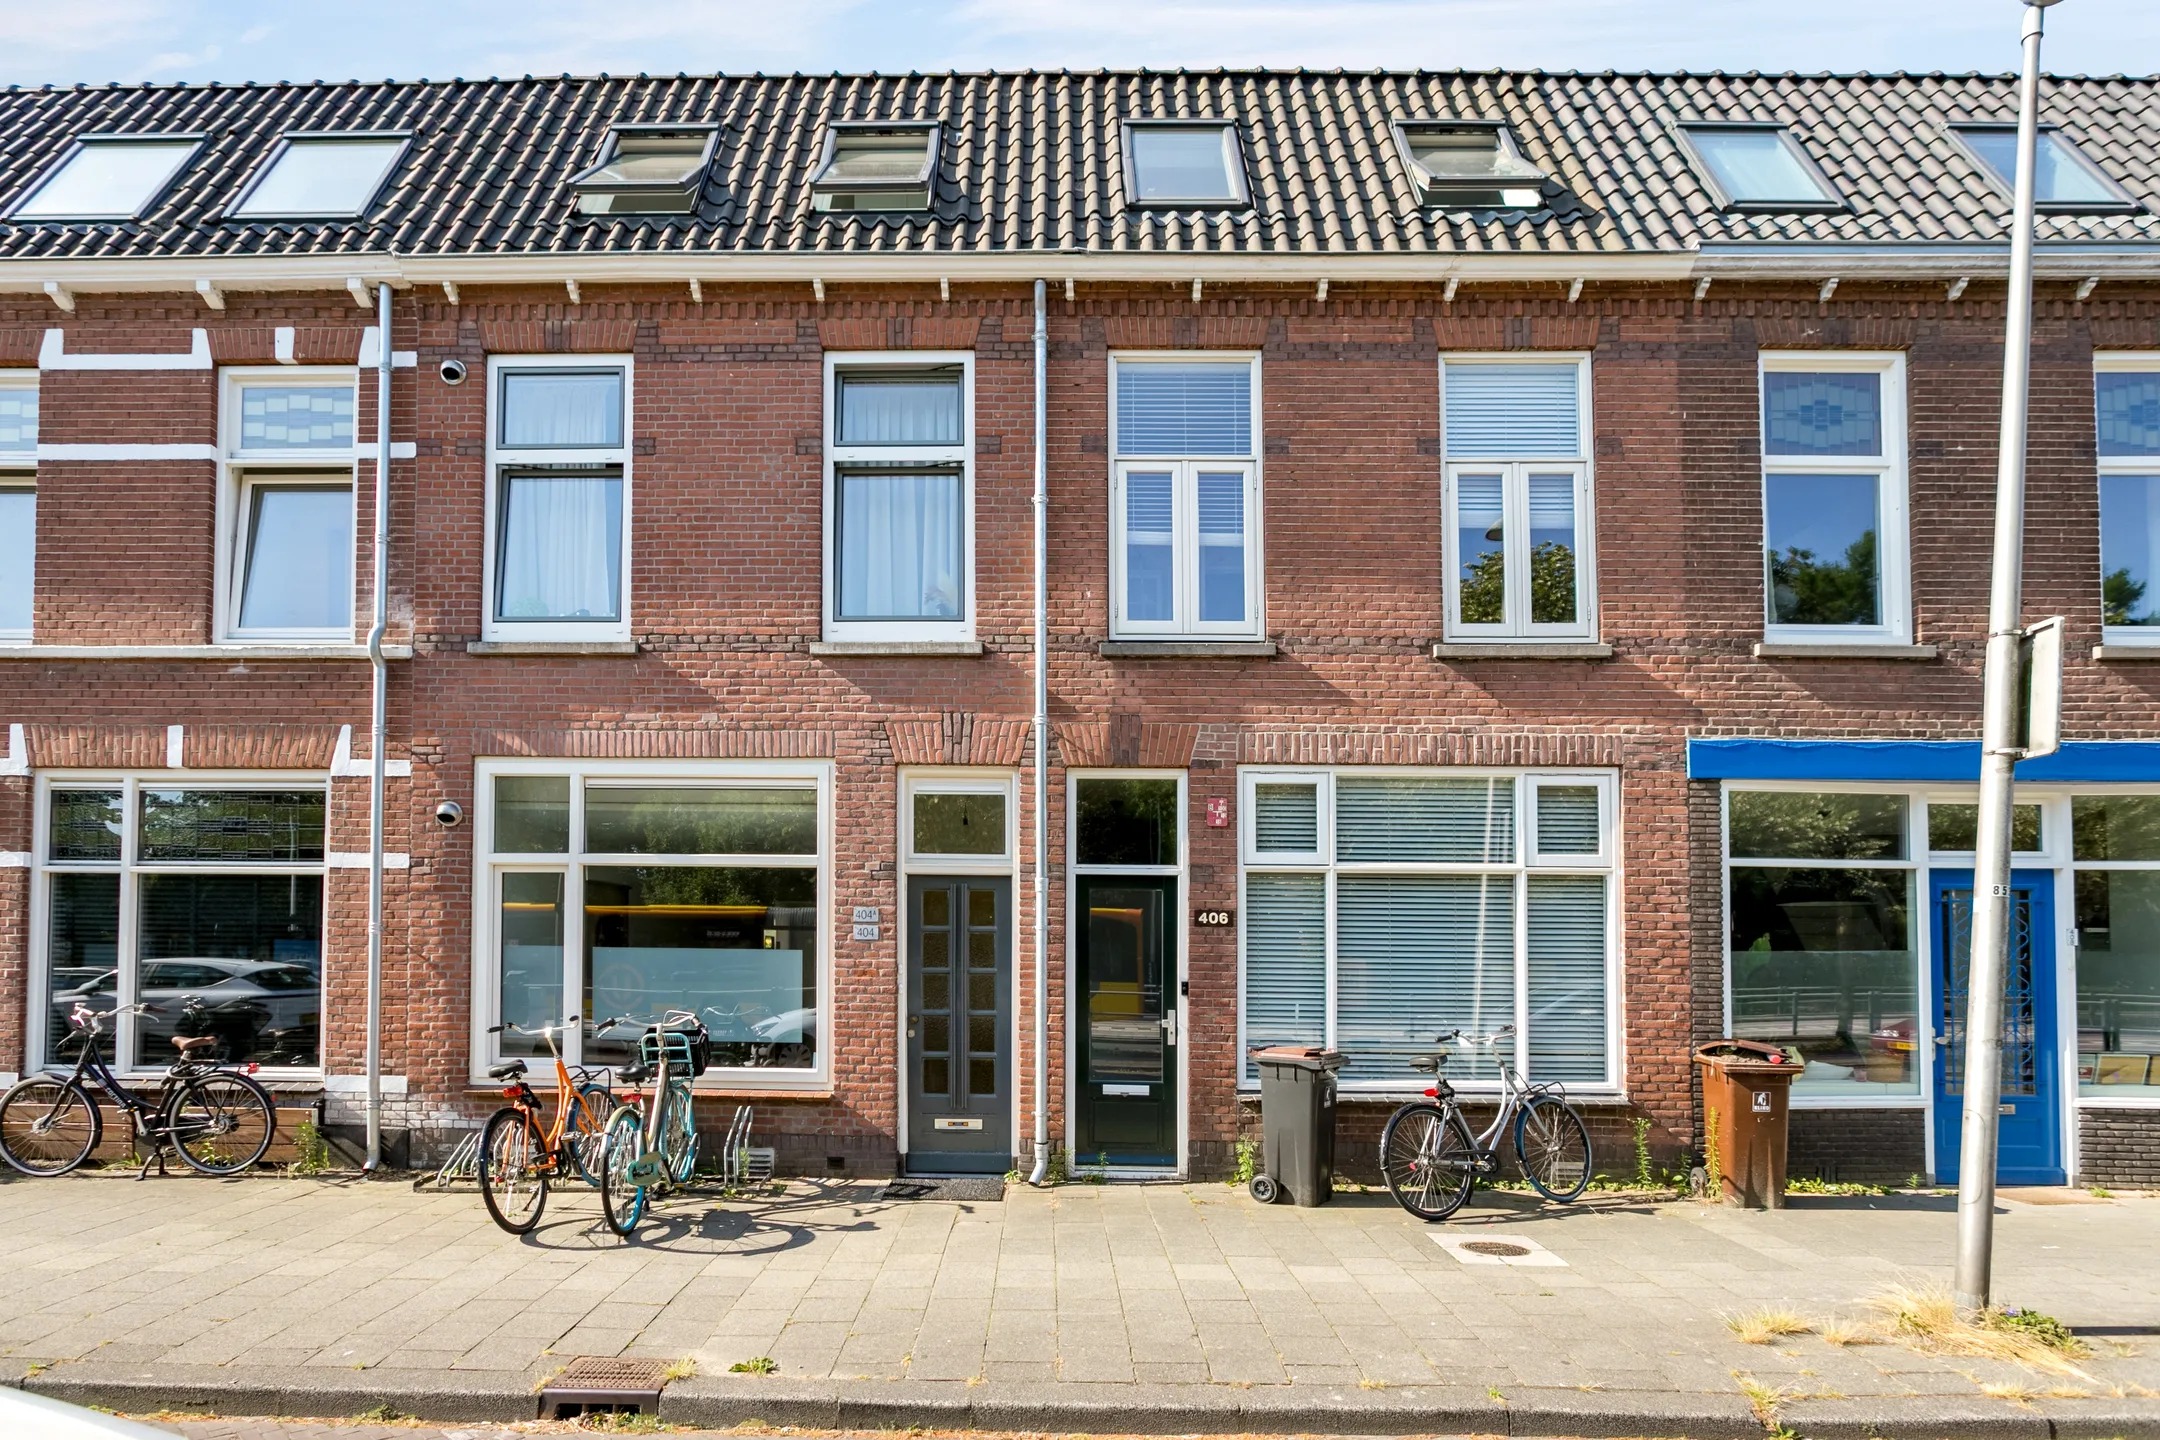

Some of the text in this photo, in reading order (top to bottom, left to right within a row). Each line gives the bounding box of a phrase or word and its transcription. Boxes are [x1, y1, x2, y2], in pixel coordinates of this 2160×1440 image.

[855, 910, 877, 919] 404A
[1198, 912, 1229, 924] 406
[857, 928, 874, 937] 404
[105, 1087, 126, 1108] cortina
